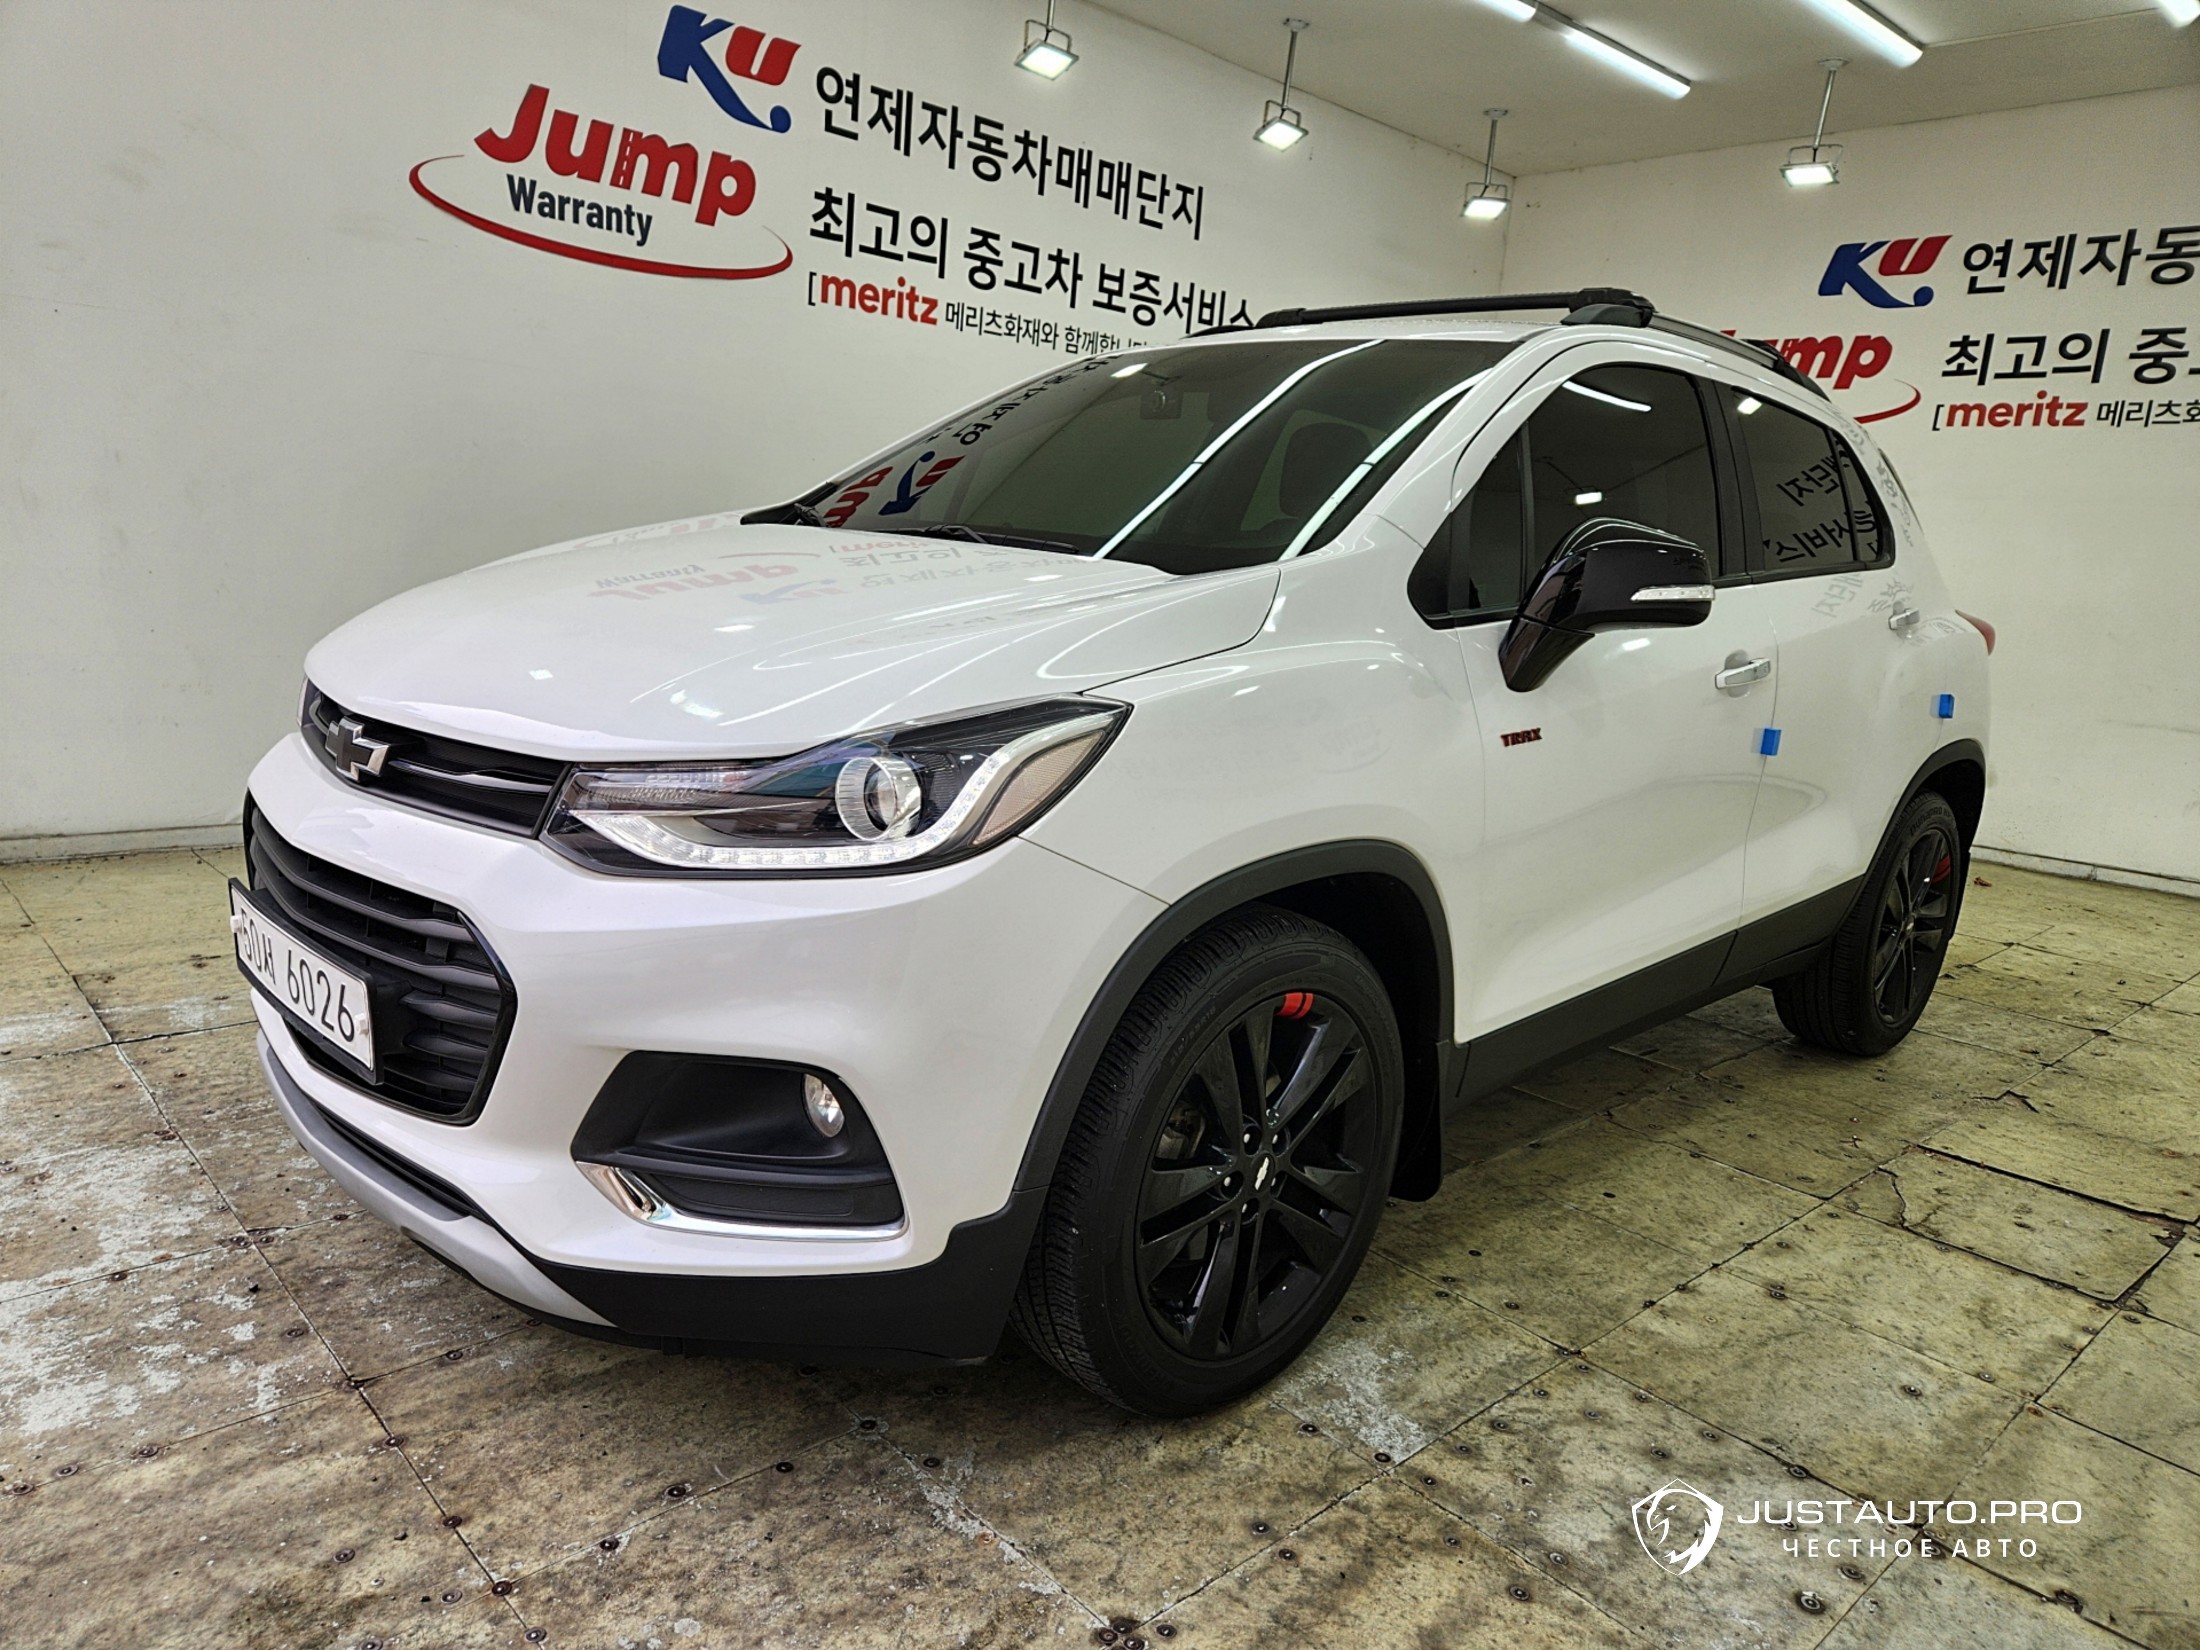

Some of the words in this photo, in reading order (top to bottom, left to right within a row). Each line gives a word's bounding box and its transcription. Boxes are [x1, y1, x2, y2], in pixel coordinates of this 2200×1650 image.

[474, 84, 756, 227] Jump
[815, 66, 1204, 241] 연제자동차매매단지
[506, 173, 653, 247] Warranty
[809, 186, 949, 279] 최고의
[963, 226, 1083, 309] 중고차
[1963, 225, 2200, 294] 연제자동
[945, 302, 1060, 350] 메리츠화재와
[1941, 328, 2111, 386] 최고의
[2128, 327, 2200, 384] 중
[1500, 727, 1543, 748] TRAX
[287, 949, 355, 1043] 6026
